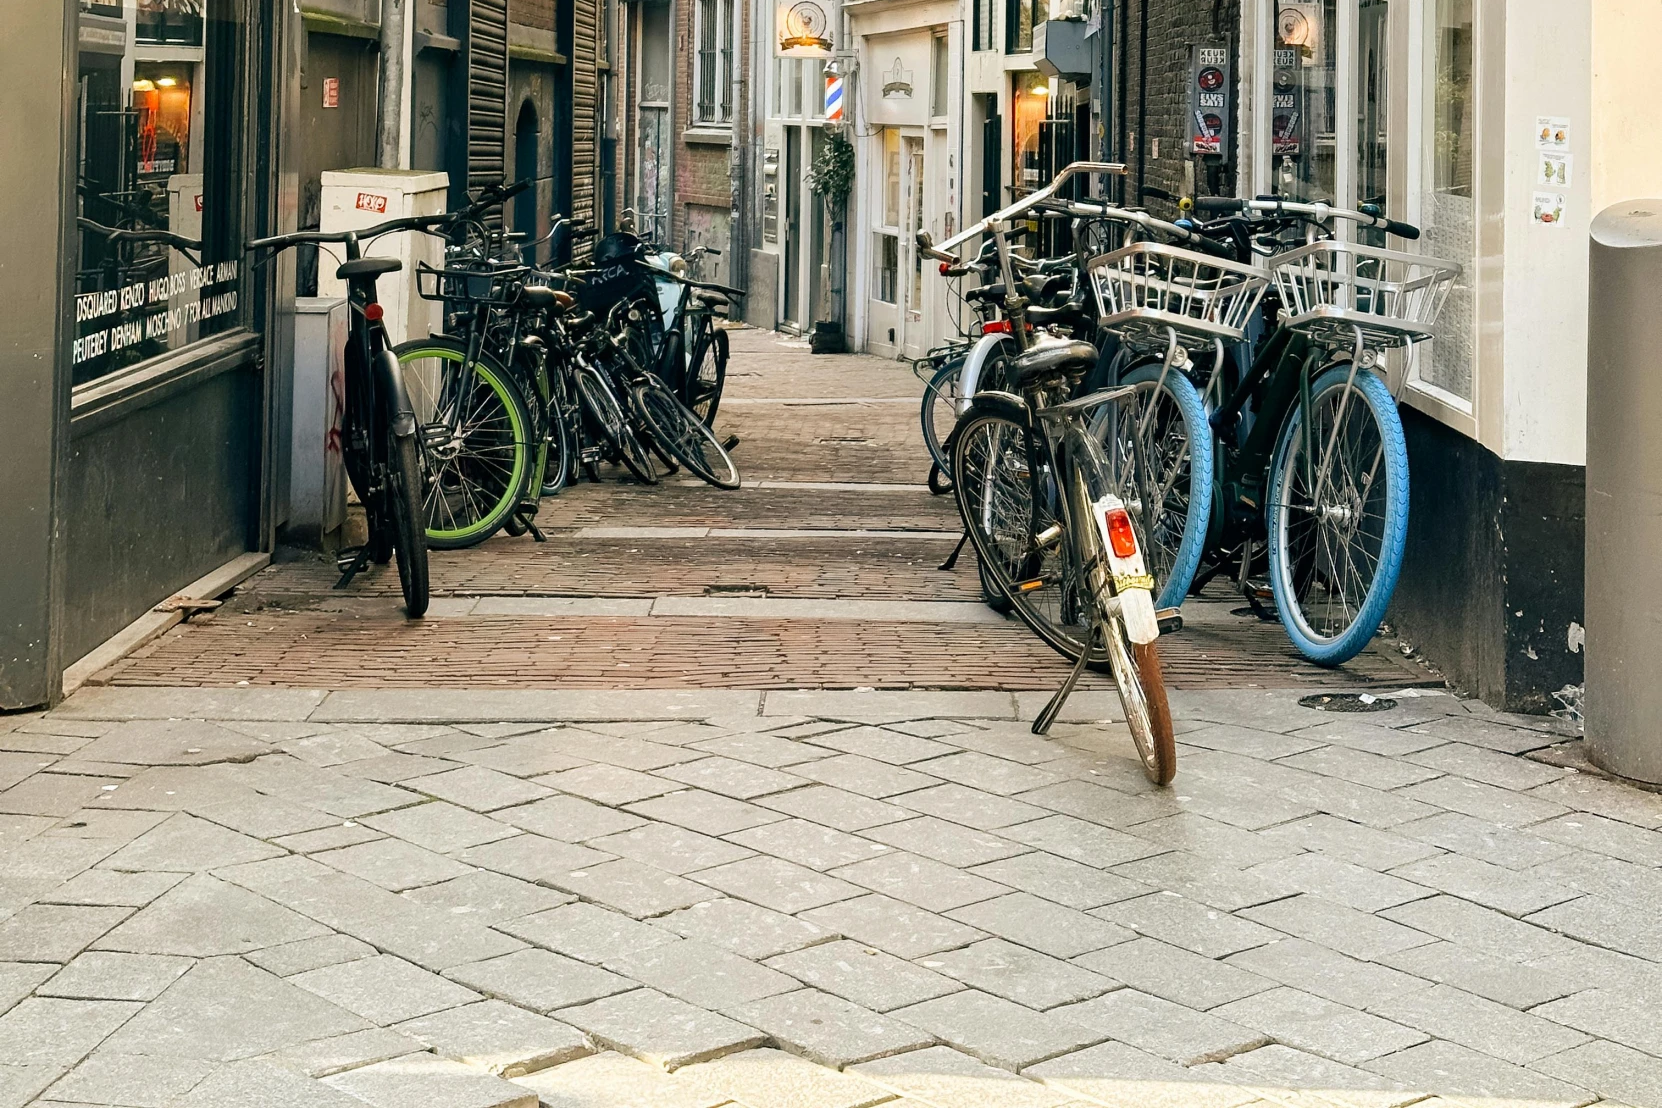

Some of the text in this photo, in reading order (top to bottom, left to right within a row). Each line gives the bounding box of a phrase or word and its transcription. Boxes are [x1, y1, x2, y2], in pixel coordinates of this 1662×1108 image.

[1201, 49, 1225, 57] KEUR
[76, 259, 238, 323] DSQUARED KENZO HUGO BOSS VERSACE ARMANI
[73, 329, 109, 365] PEUTEREY
[111, 319, 142, 352] DENHAM
[145, 308, 182, 339] MOSCHINO
[189, 300, 201, 323] FOR
[200, 297, 211, 319] ALL
[211, 291, 238, 316] MANKIND
